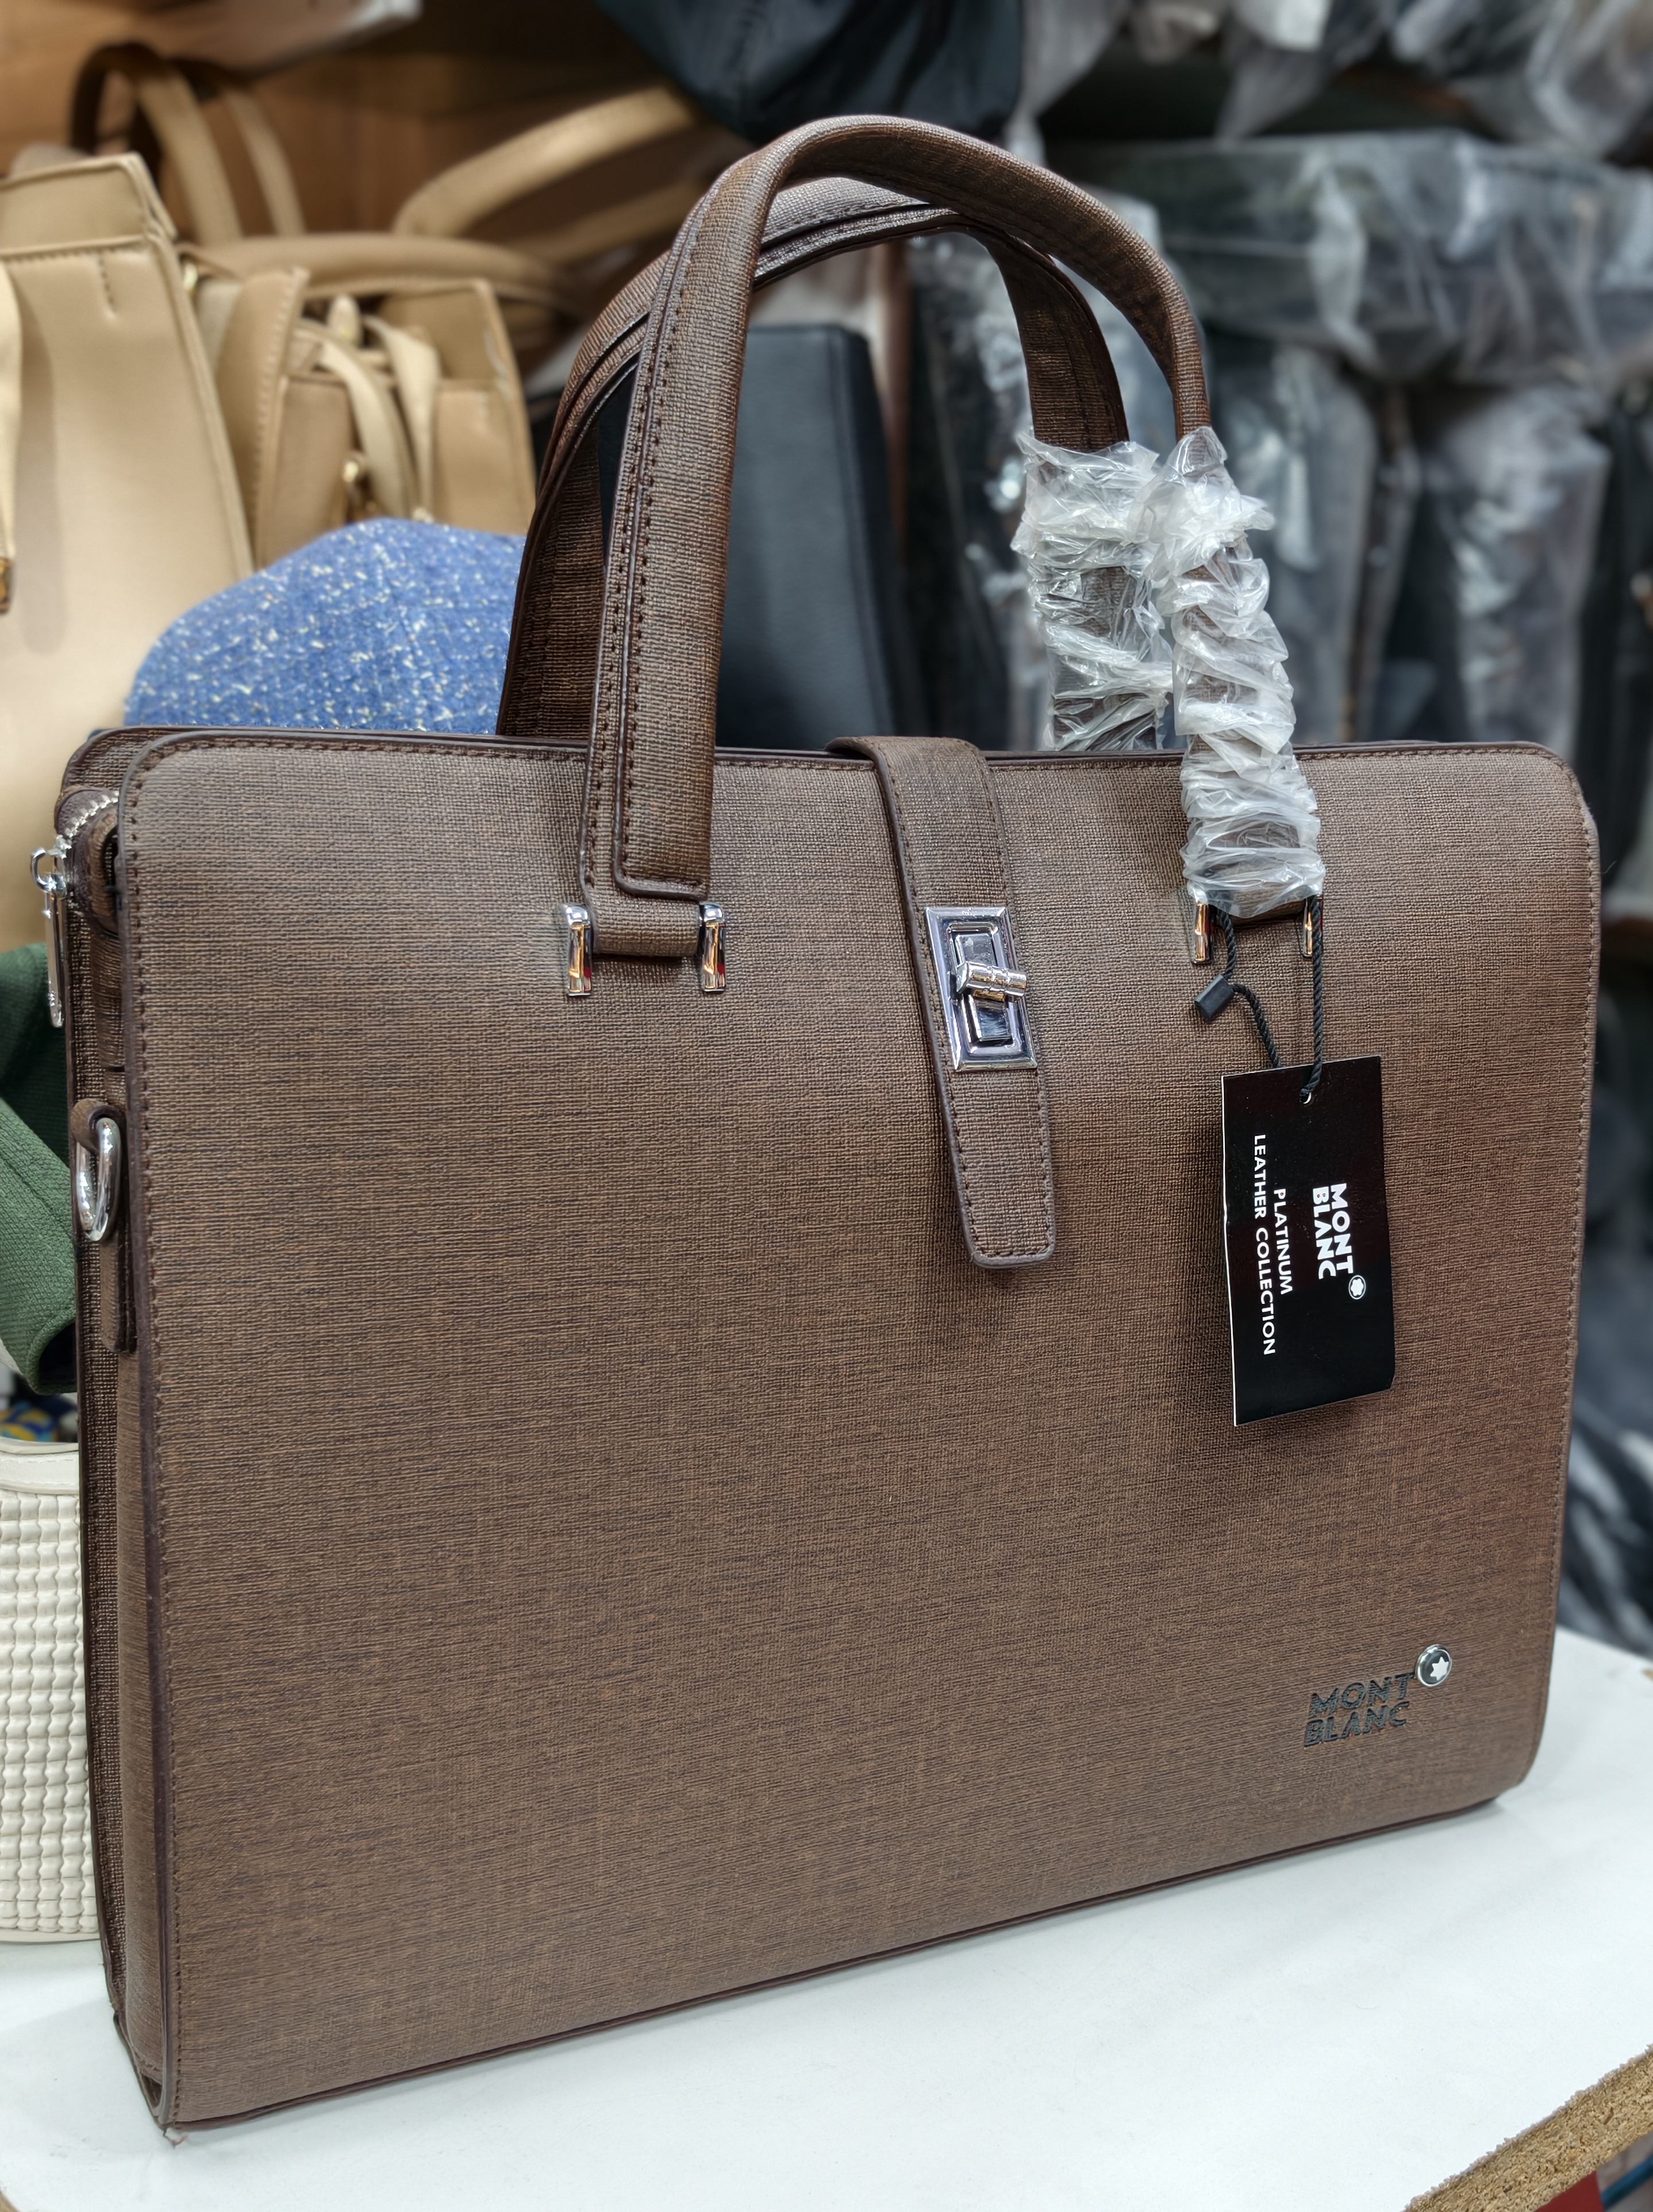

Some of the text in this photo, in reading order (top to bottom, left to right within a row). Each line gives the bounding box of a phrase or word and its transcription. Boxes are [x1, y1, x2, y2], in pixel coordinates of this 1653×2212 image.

[1254, 1134, 1276, 1355] LEATHER COLLECTION
[1274, 1188, 1293, 1295] PLATINUM
[1312, 1186, 1336, 1280] BLANC
[1330, 1183, 1354, 1275] MONT
[1304, 1701, 1410, 1747] BLANC
[1308, 1672, 1416, 1719] MONT
